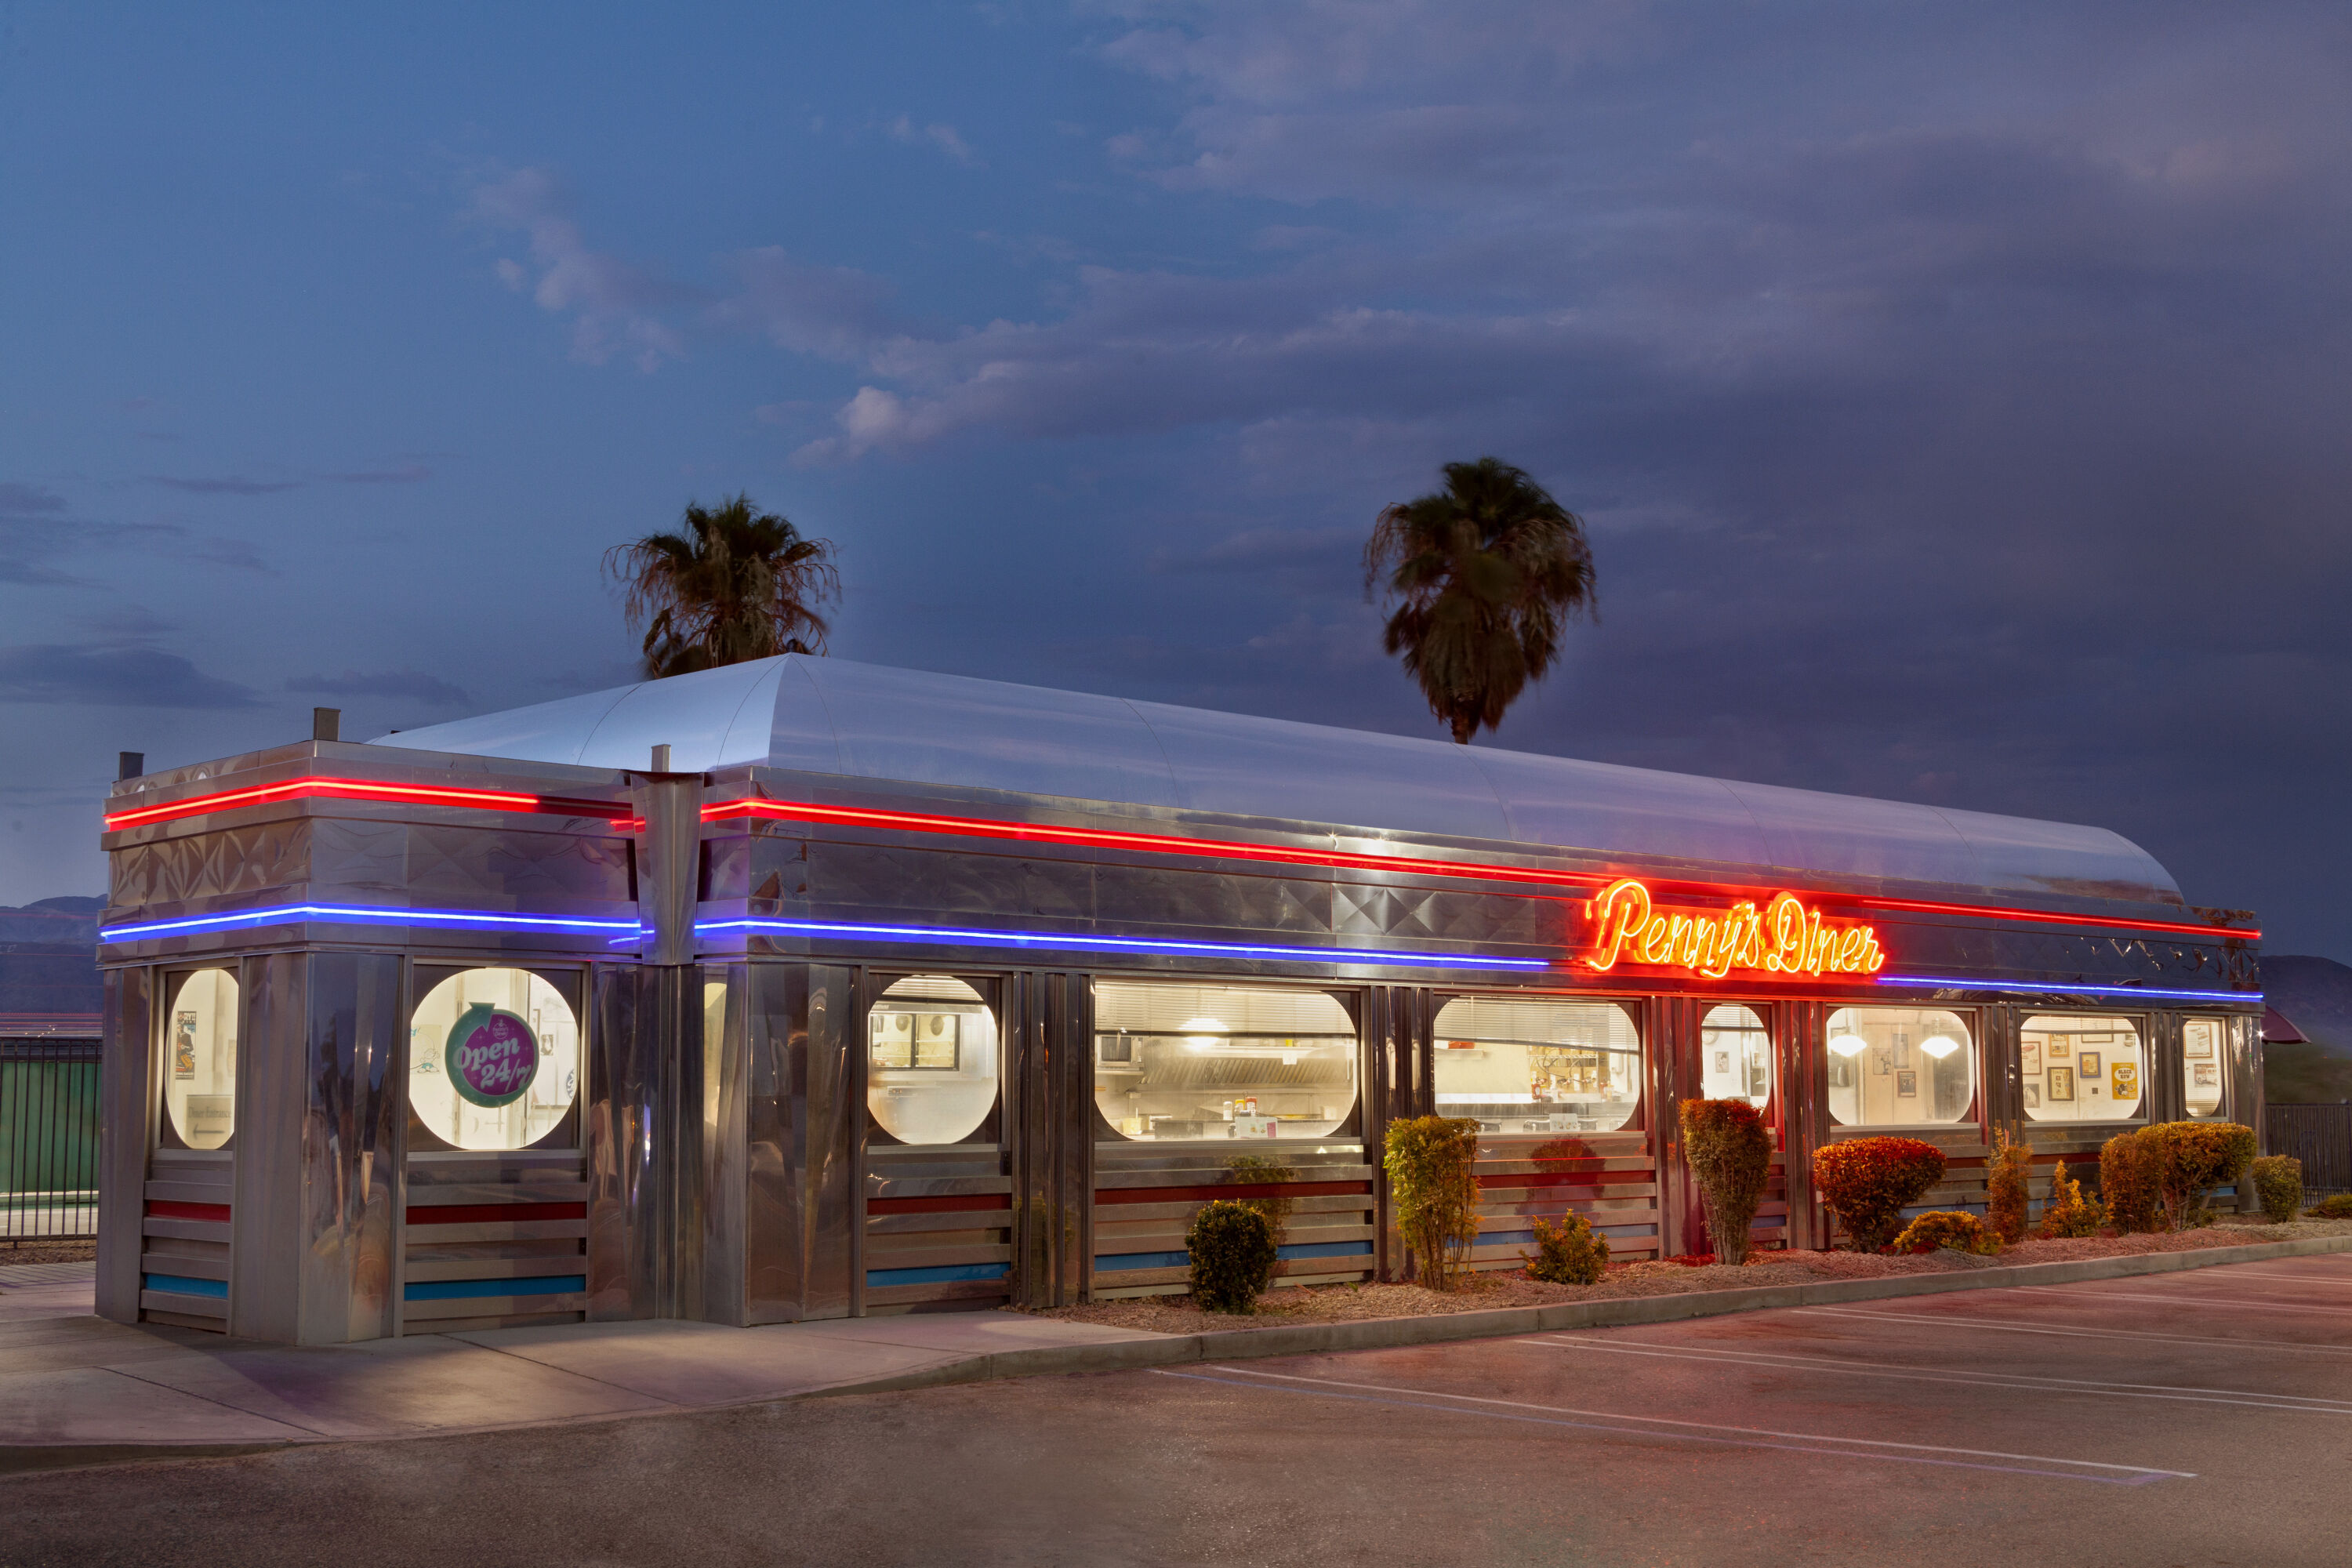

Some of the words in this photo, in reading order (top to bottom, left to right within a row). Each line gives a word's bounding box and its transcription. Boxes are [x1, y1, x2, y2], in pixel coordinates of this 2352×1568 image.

[1585, 880, 1759, 978] Penny's
[1766, 892, 1885, 977] Diner
[453, 1037, 521, 1072] Open
[480, 1058, 532, 1093] 24/7
[188, 1106, 205, 1118] Diner
[206, 1106, 231, 1118] Entrance
